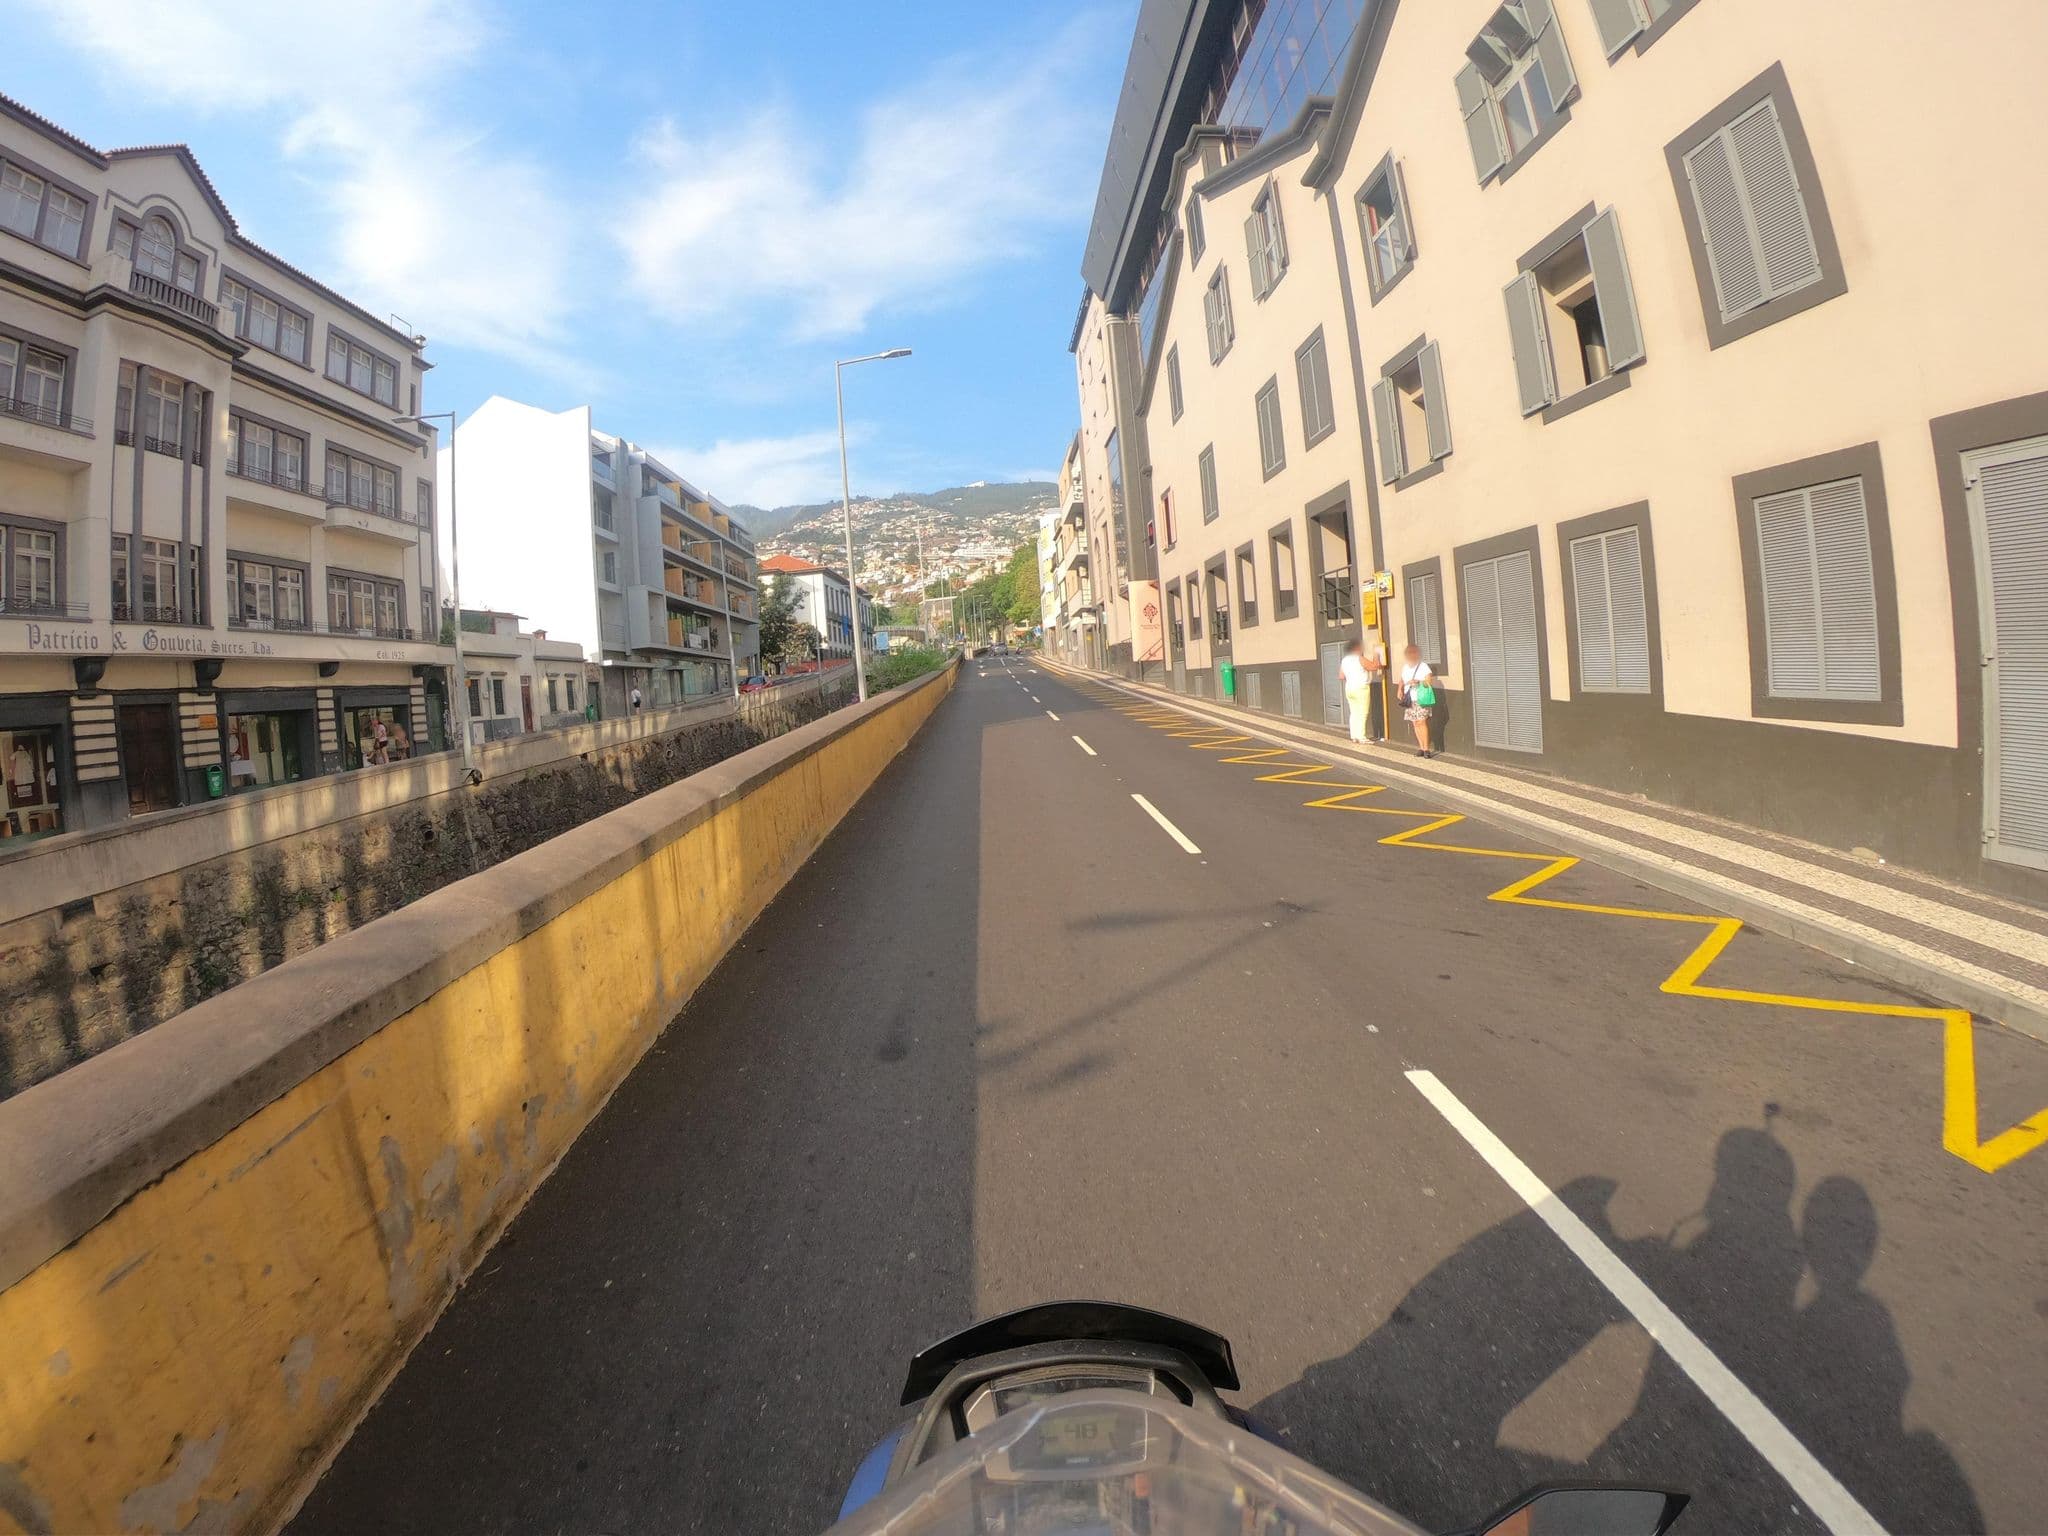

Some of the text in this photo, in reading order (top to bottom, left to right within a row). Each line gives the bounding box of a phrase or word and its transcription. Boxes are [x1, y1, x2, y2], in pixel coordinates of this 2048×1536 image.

[112, 631, 128, 650] &
[143, 628, 206, 653] Gouveia,
[252, 641, 274, 655] Lda.
